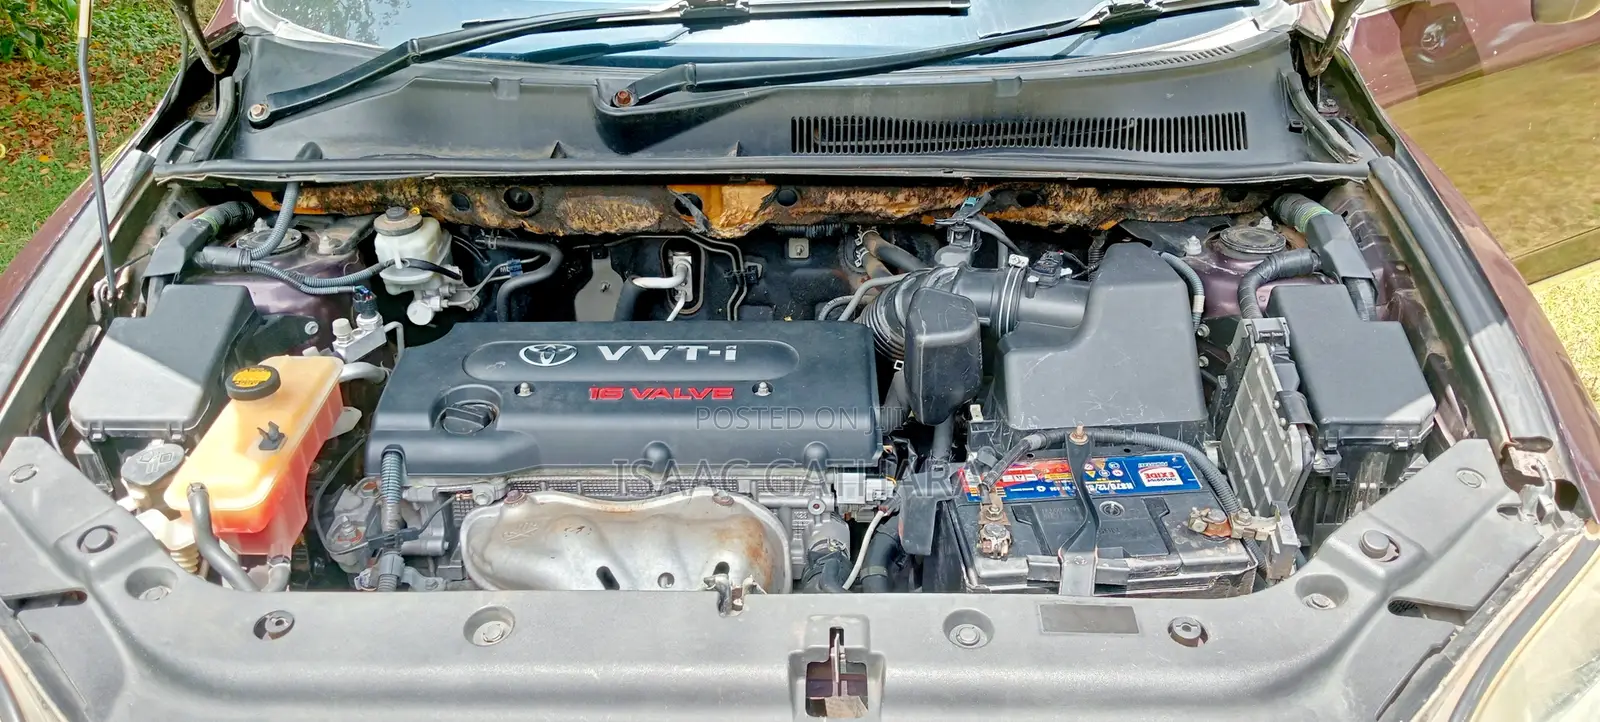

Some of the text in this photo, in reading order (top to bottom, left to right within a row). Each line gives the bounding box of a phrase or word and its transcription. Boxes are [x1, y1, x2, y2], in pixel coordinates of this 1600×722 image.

[597, 345, 738, 361] VVT-i
[589, 386, 736, 400] 16 VALVE
